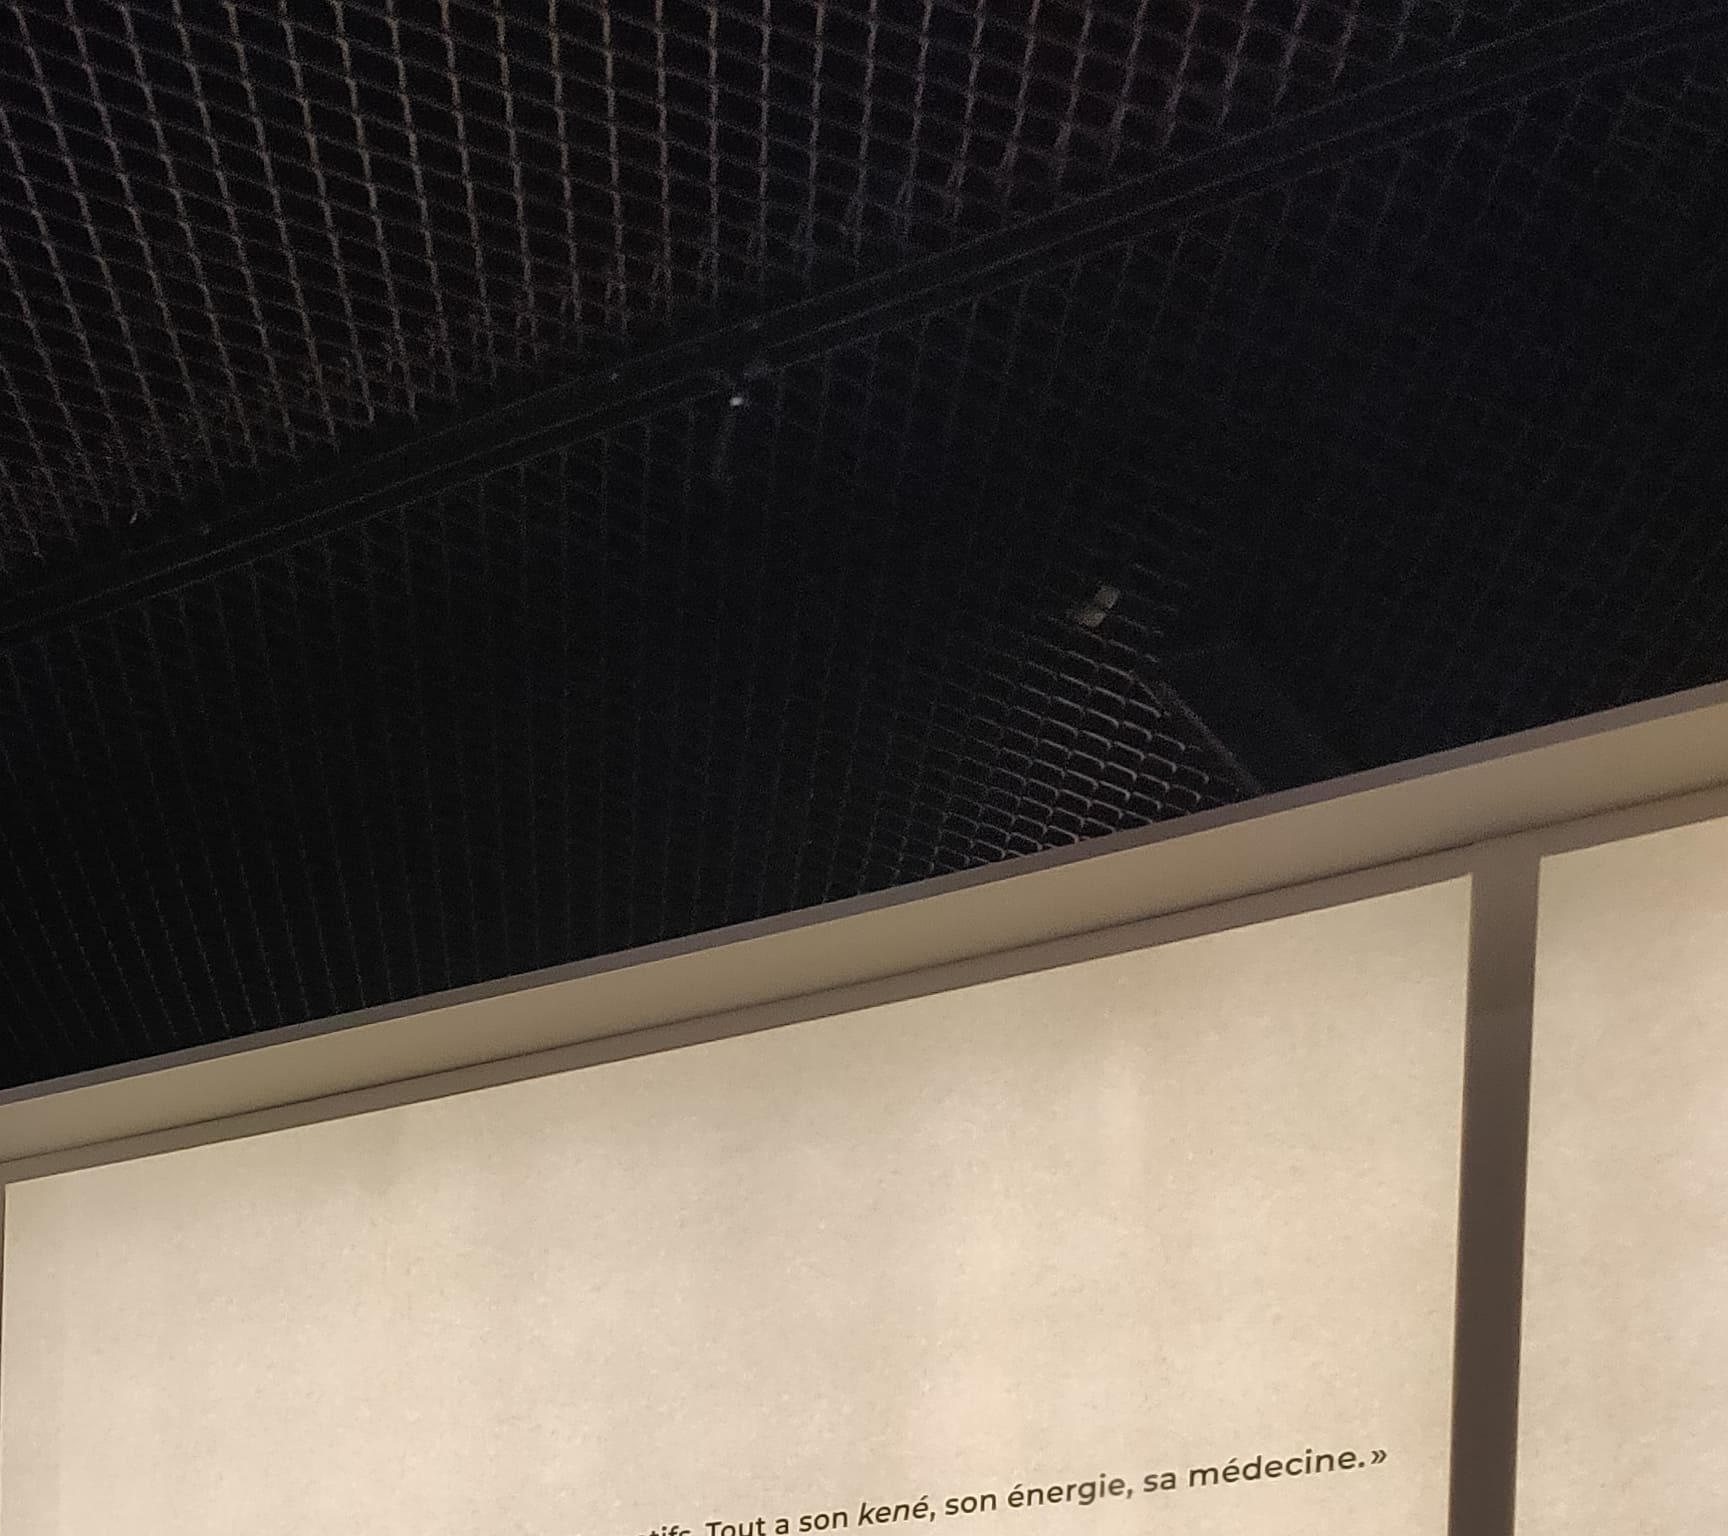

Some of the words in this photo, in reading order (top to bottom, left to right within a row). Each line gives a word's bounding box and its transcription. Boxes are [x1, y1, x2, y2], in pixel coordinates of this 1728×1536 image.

[774, 1518, 790, 1536] a
[798, 1511, 849, 1533] son
[857, 1494, 936, 1527] kené,
[944, 1493, 997, 1516] son
[1007, 1472, 1134, 1508] énergie,
[1143, 1472, 1177, 1493] sa
